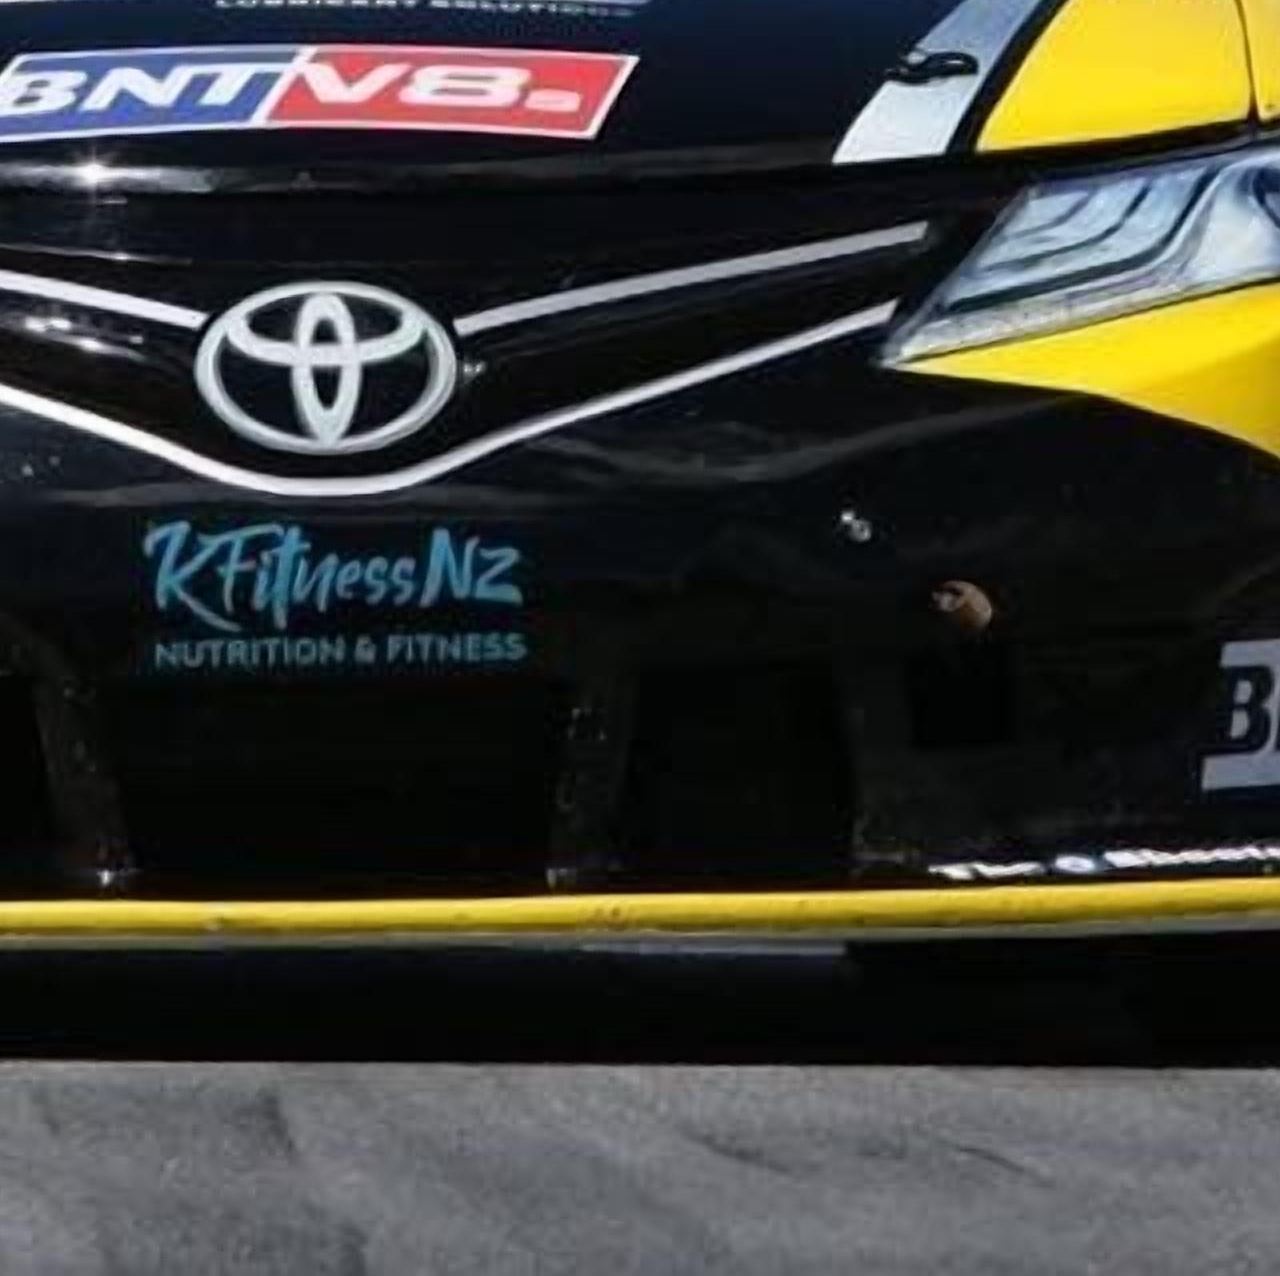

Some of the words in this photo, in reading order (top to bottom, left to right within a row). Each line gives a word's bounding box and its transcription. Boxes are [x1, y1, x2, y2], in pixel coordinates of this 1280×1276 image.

[154, 635, 344, 669] NUTRITION
[355, 635, 376, 665] &
[386, 631, 527, 664] FITNESS
